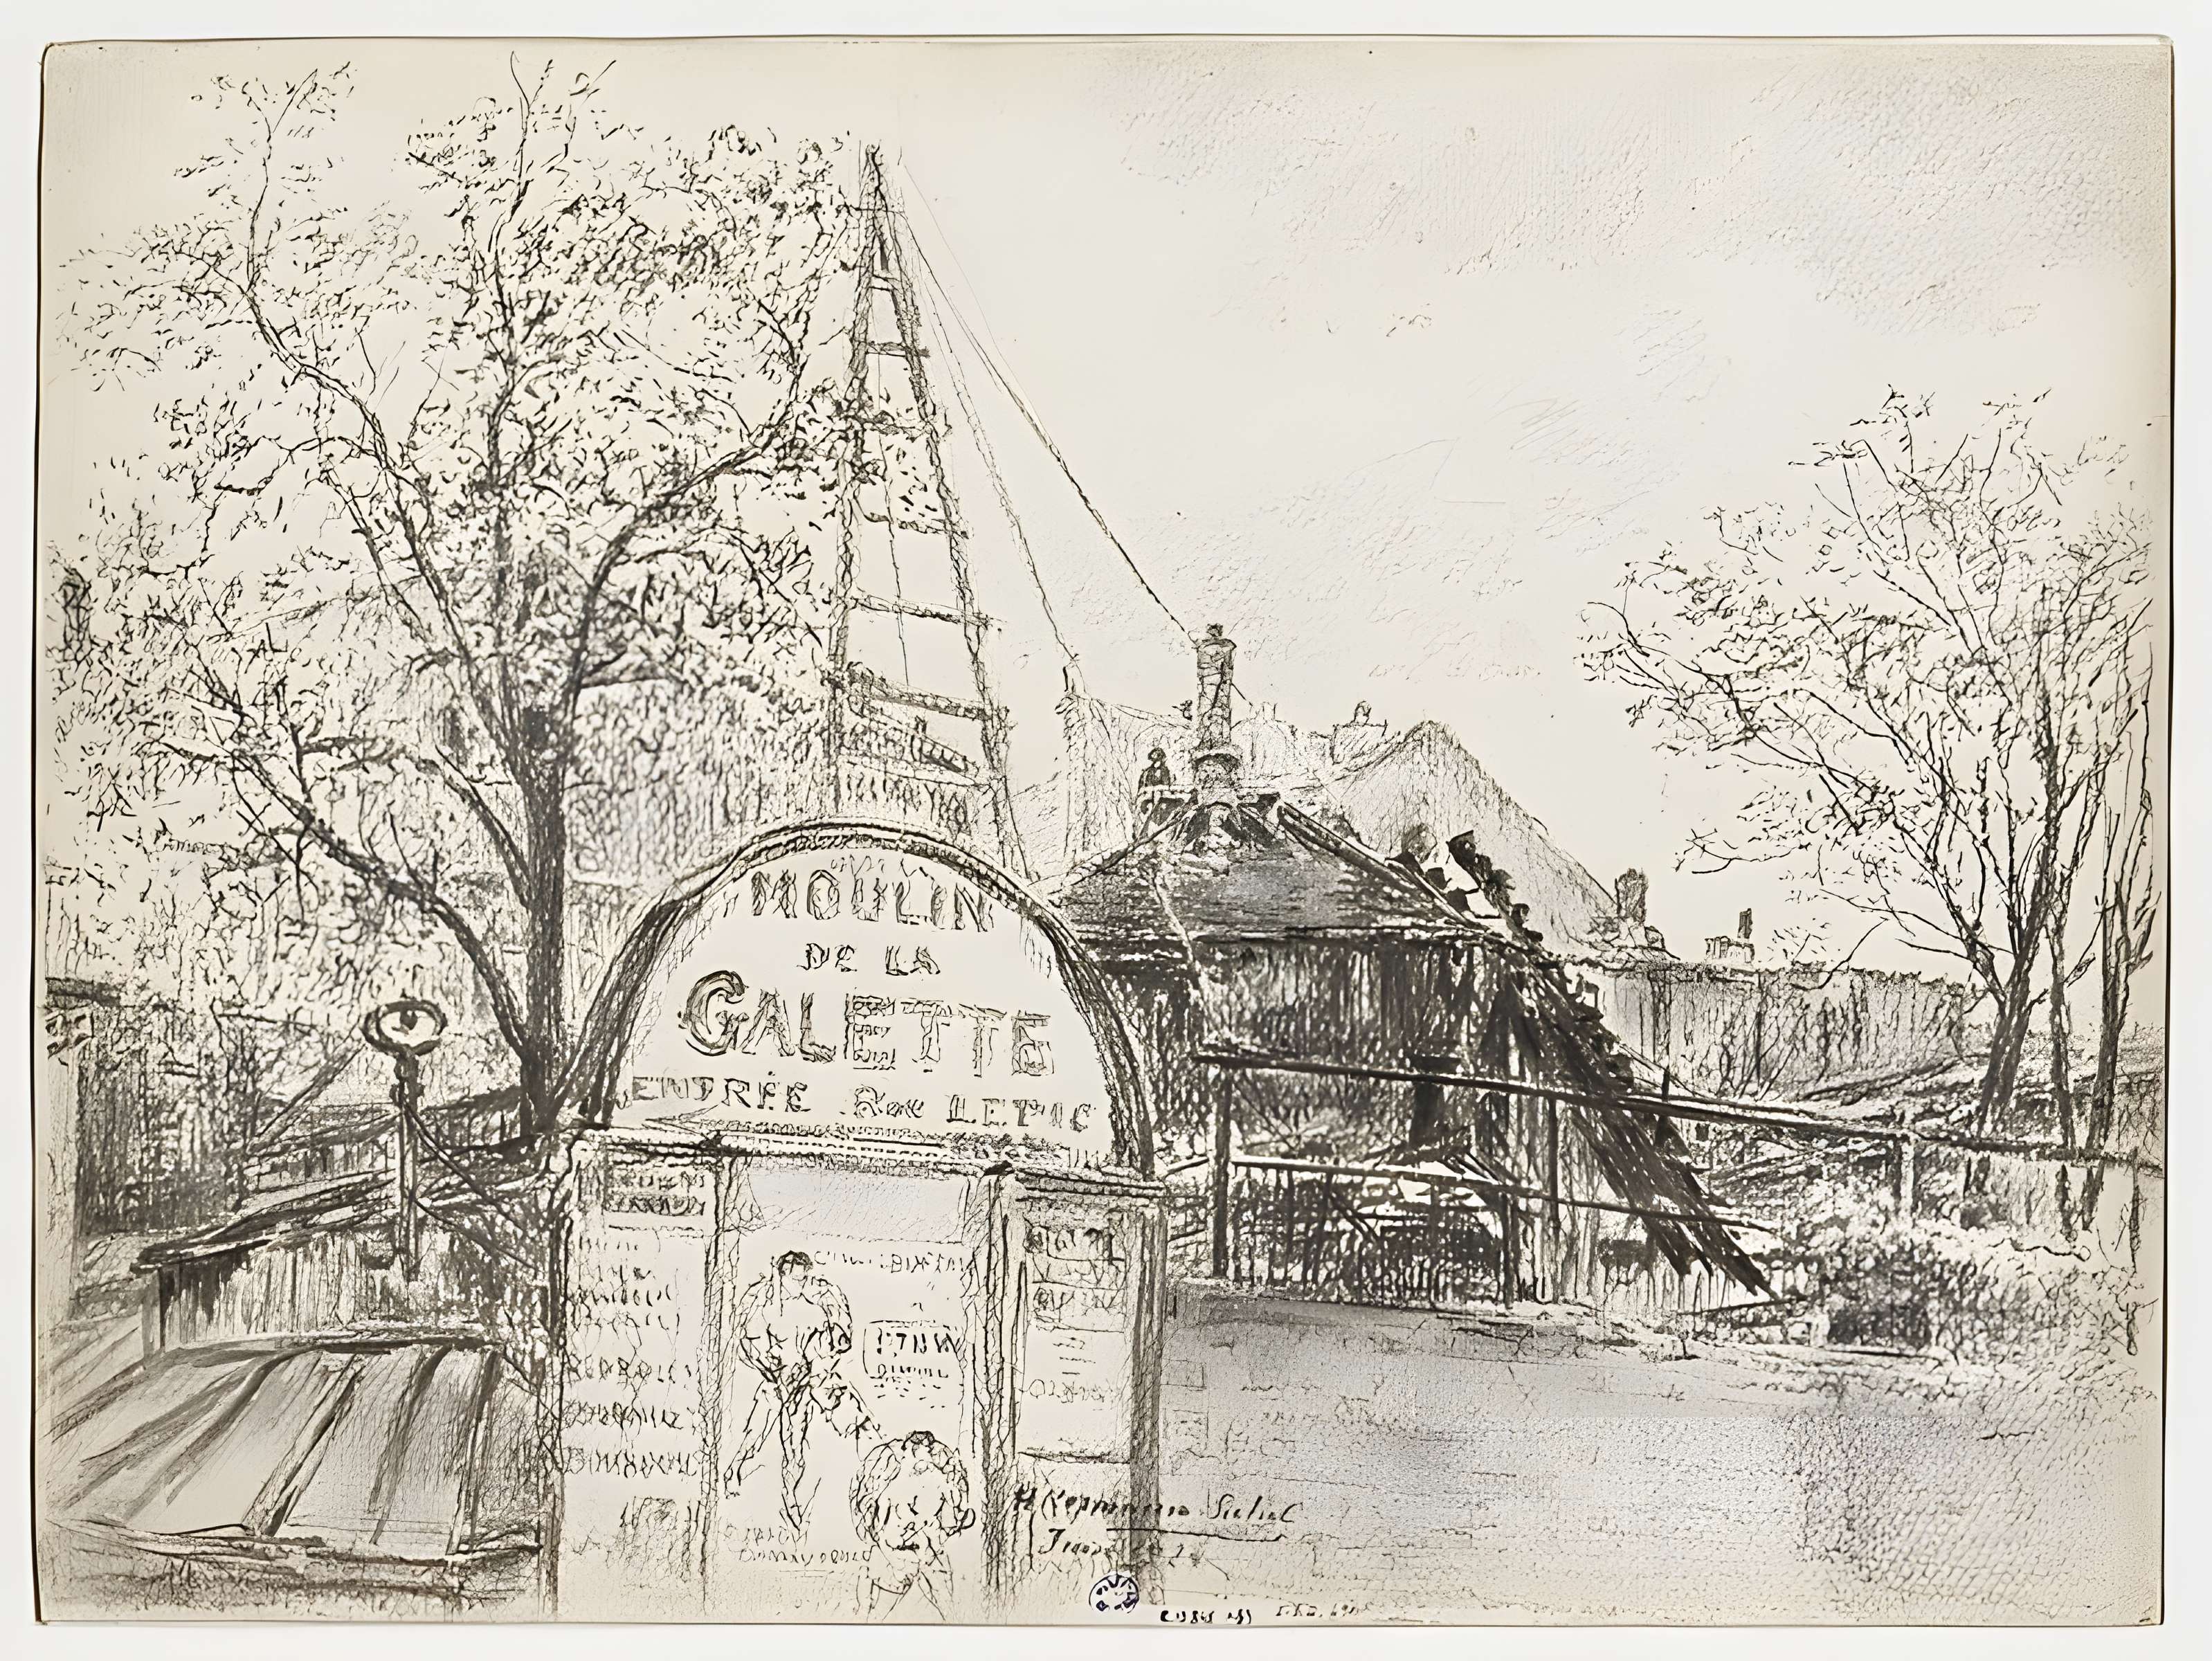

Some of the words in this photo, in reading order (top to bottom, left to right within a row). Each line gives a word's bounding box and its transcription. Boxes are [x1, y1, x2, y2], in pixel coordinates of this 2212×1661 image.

[750, 866, 994, 933] MOULIN
[797, 943, 858, 972] DE
[885, 945, 941, 976] LA
[679, 970, 1055, 1078] GALETTE
[945, 1093, 1096, 1133] LEPIC
